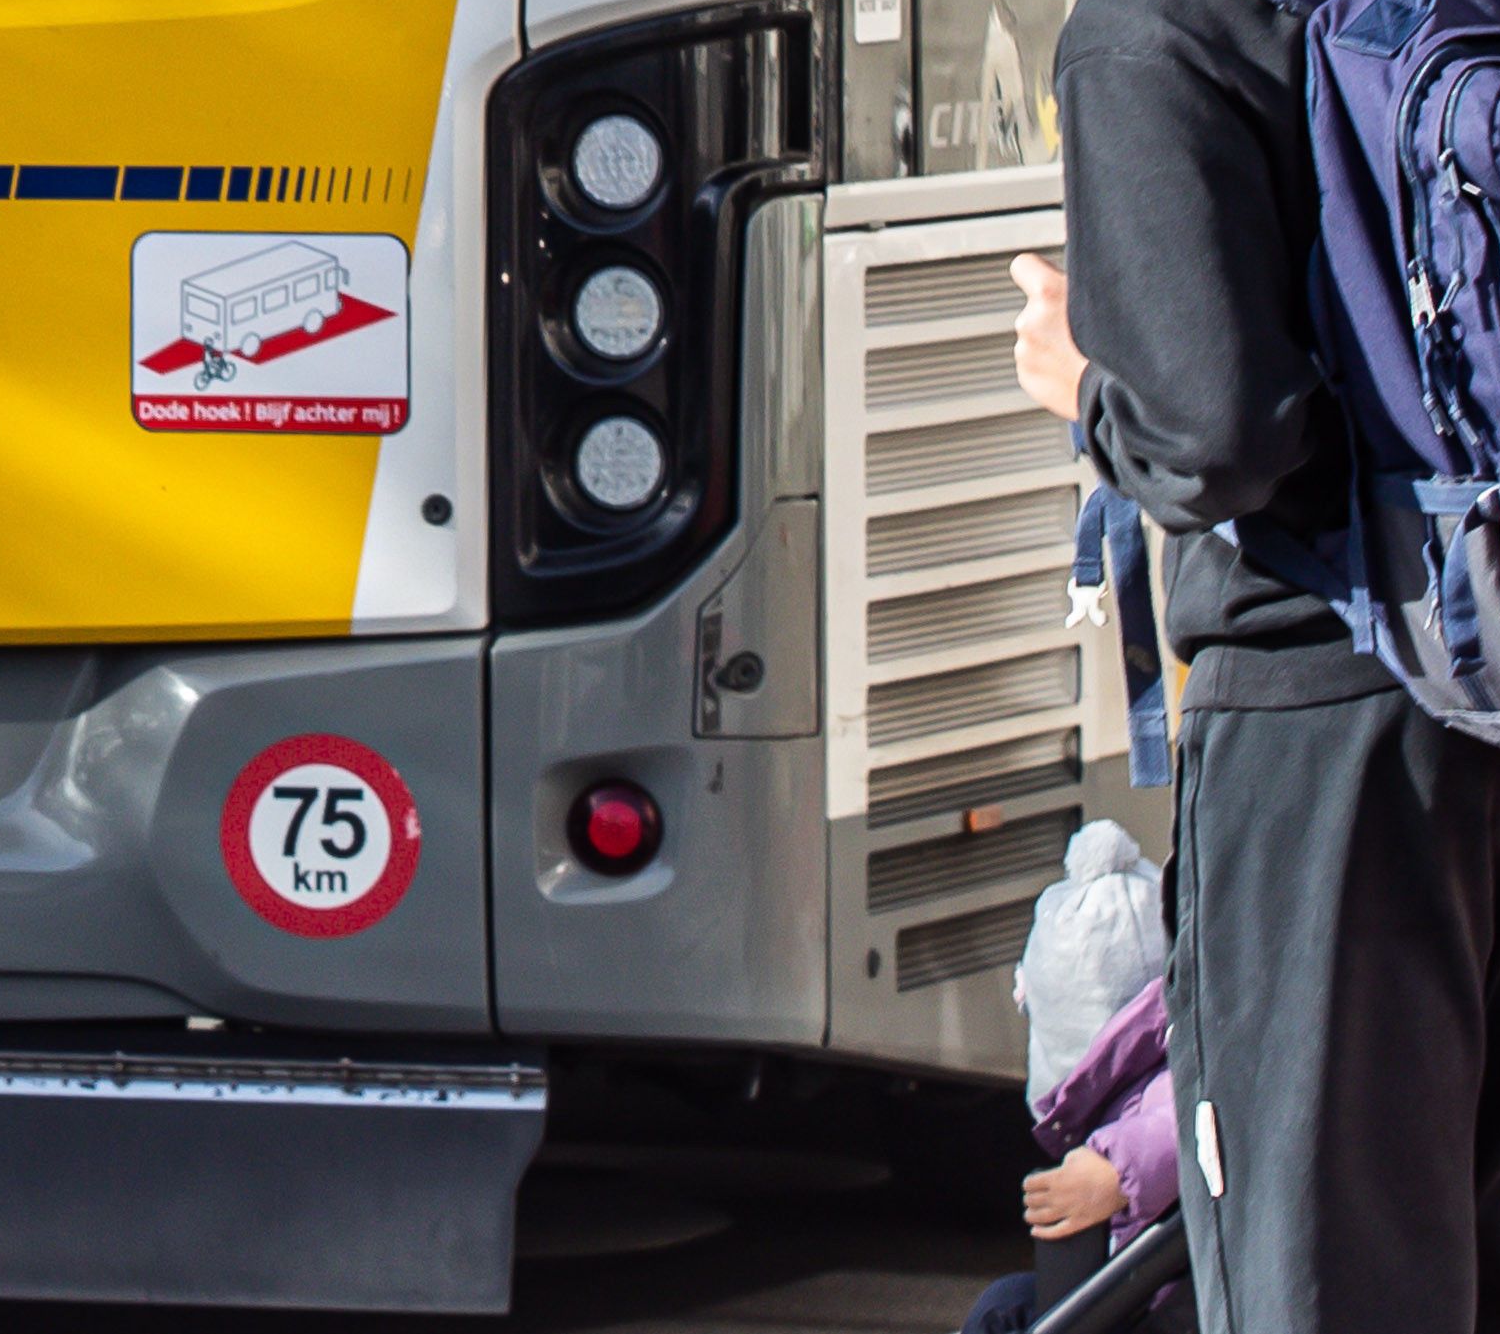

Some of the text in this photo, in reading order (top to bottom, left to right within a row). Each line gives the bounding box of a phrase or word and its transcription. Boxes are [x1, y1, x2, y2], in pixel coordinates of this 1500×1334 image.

[138, 400, 189, 421] Dode
[255, 401, 292, 428] Blijf
[294, 403, 357, 423] achter
[272, 786, 367, 859] 75
[293, 861, 348, 894] km
